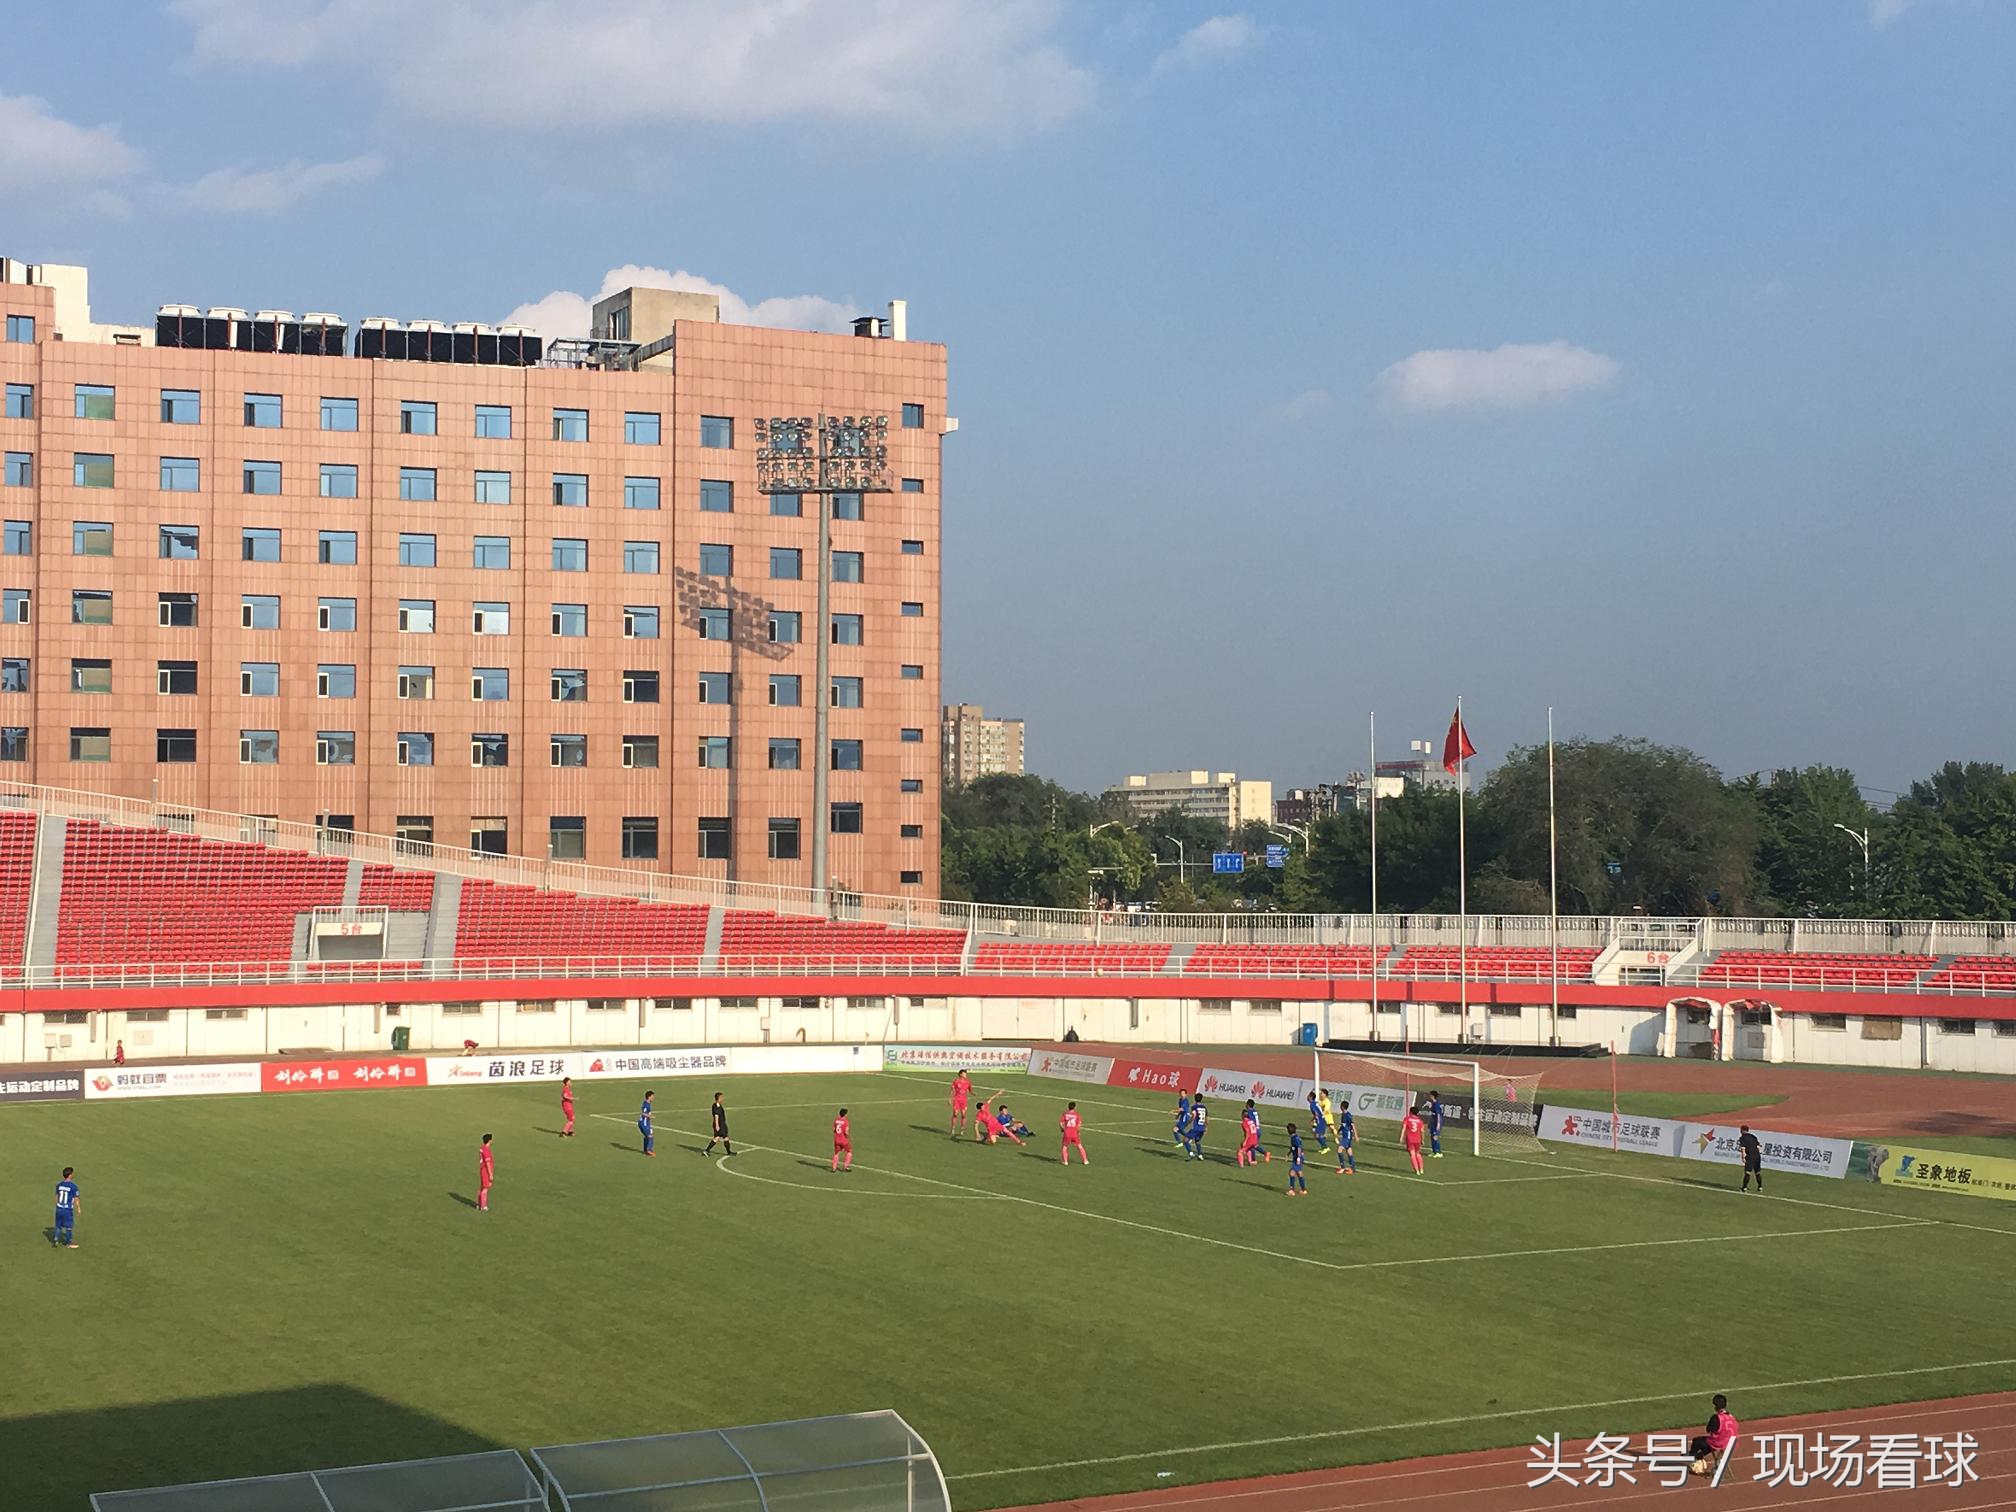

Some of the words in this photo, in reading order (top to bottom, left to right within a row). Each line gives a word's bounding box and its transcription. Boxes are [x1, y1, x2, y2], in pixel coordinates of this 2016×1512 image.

[488, 1059, 564, 1078] 茵浪足球
[615, 1055, 727, 1071] 中国高端吸尘器品牌
[1219, 1082, 1246, 1094] HUAWEI
[1266, 1088, 1294, 1101] HUAWEI
[1411, 1121, 1418, 1133] 3
[1916, 1163, 1972, 1185] 圣象地板
[59, 1190, 68, 1205] 11
